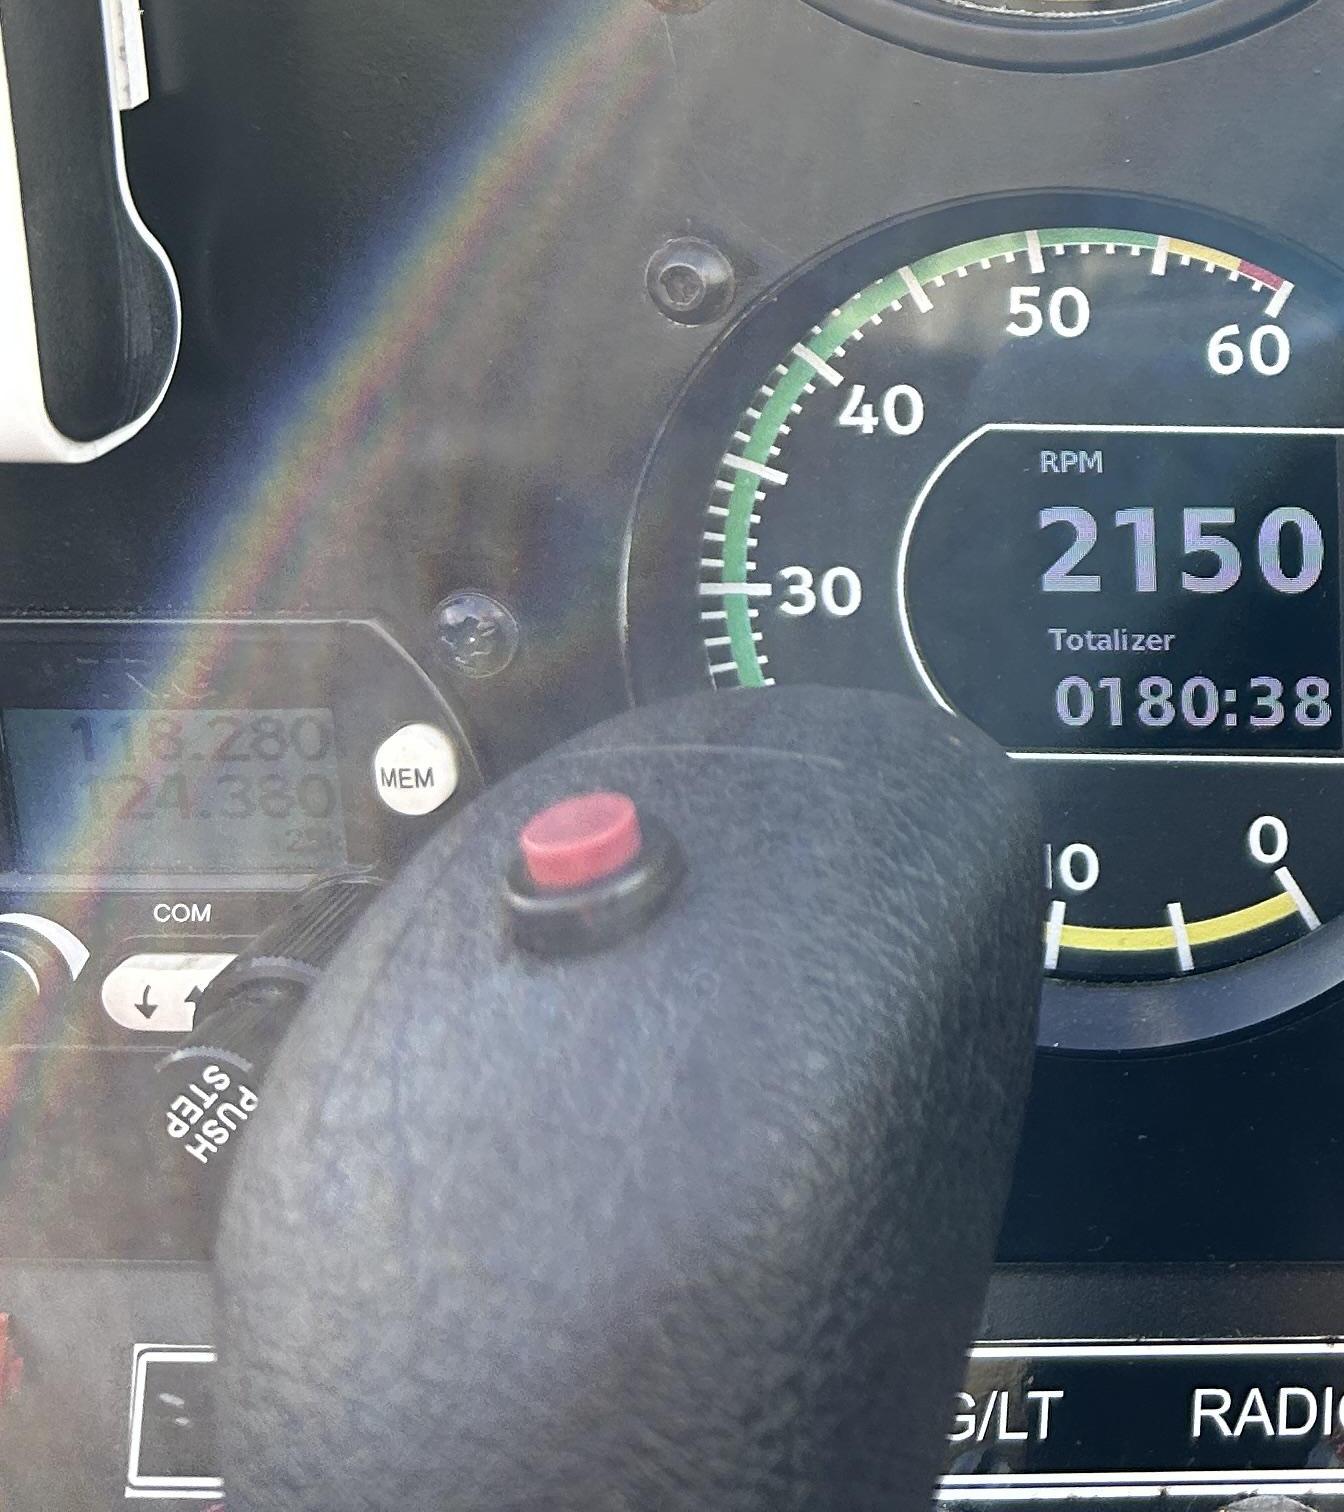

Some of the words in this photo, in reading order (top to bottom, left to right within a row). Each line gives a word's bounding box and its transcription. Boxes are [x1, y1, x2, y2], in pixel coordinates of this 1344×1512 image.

[1005, 286, 1090, 338] 50
[1207, 324, 1290, 377] 60
[838, 384, 924, 436] 40
[1039, 449, 1103, 474] RPM
[1039, 505, 1325, 594] 2150
[780, 567, 861, 618] 30
[1048, 627, 1175, 653] Totalizer
[1056, 675, 1332, 728] 0180:38
[381, 767, 434, 788] MEM
[1249, 815, 1289, 866] 0
[154, 903, 212, 923] COM
[166, 1065, 230, 1138] STEP
[185, 1085, 258, 1163] PUSH
